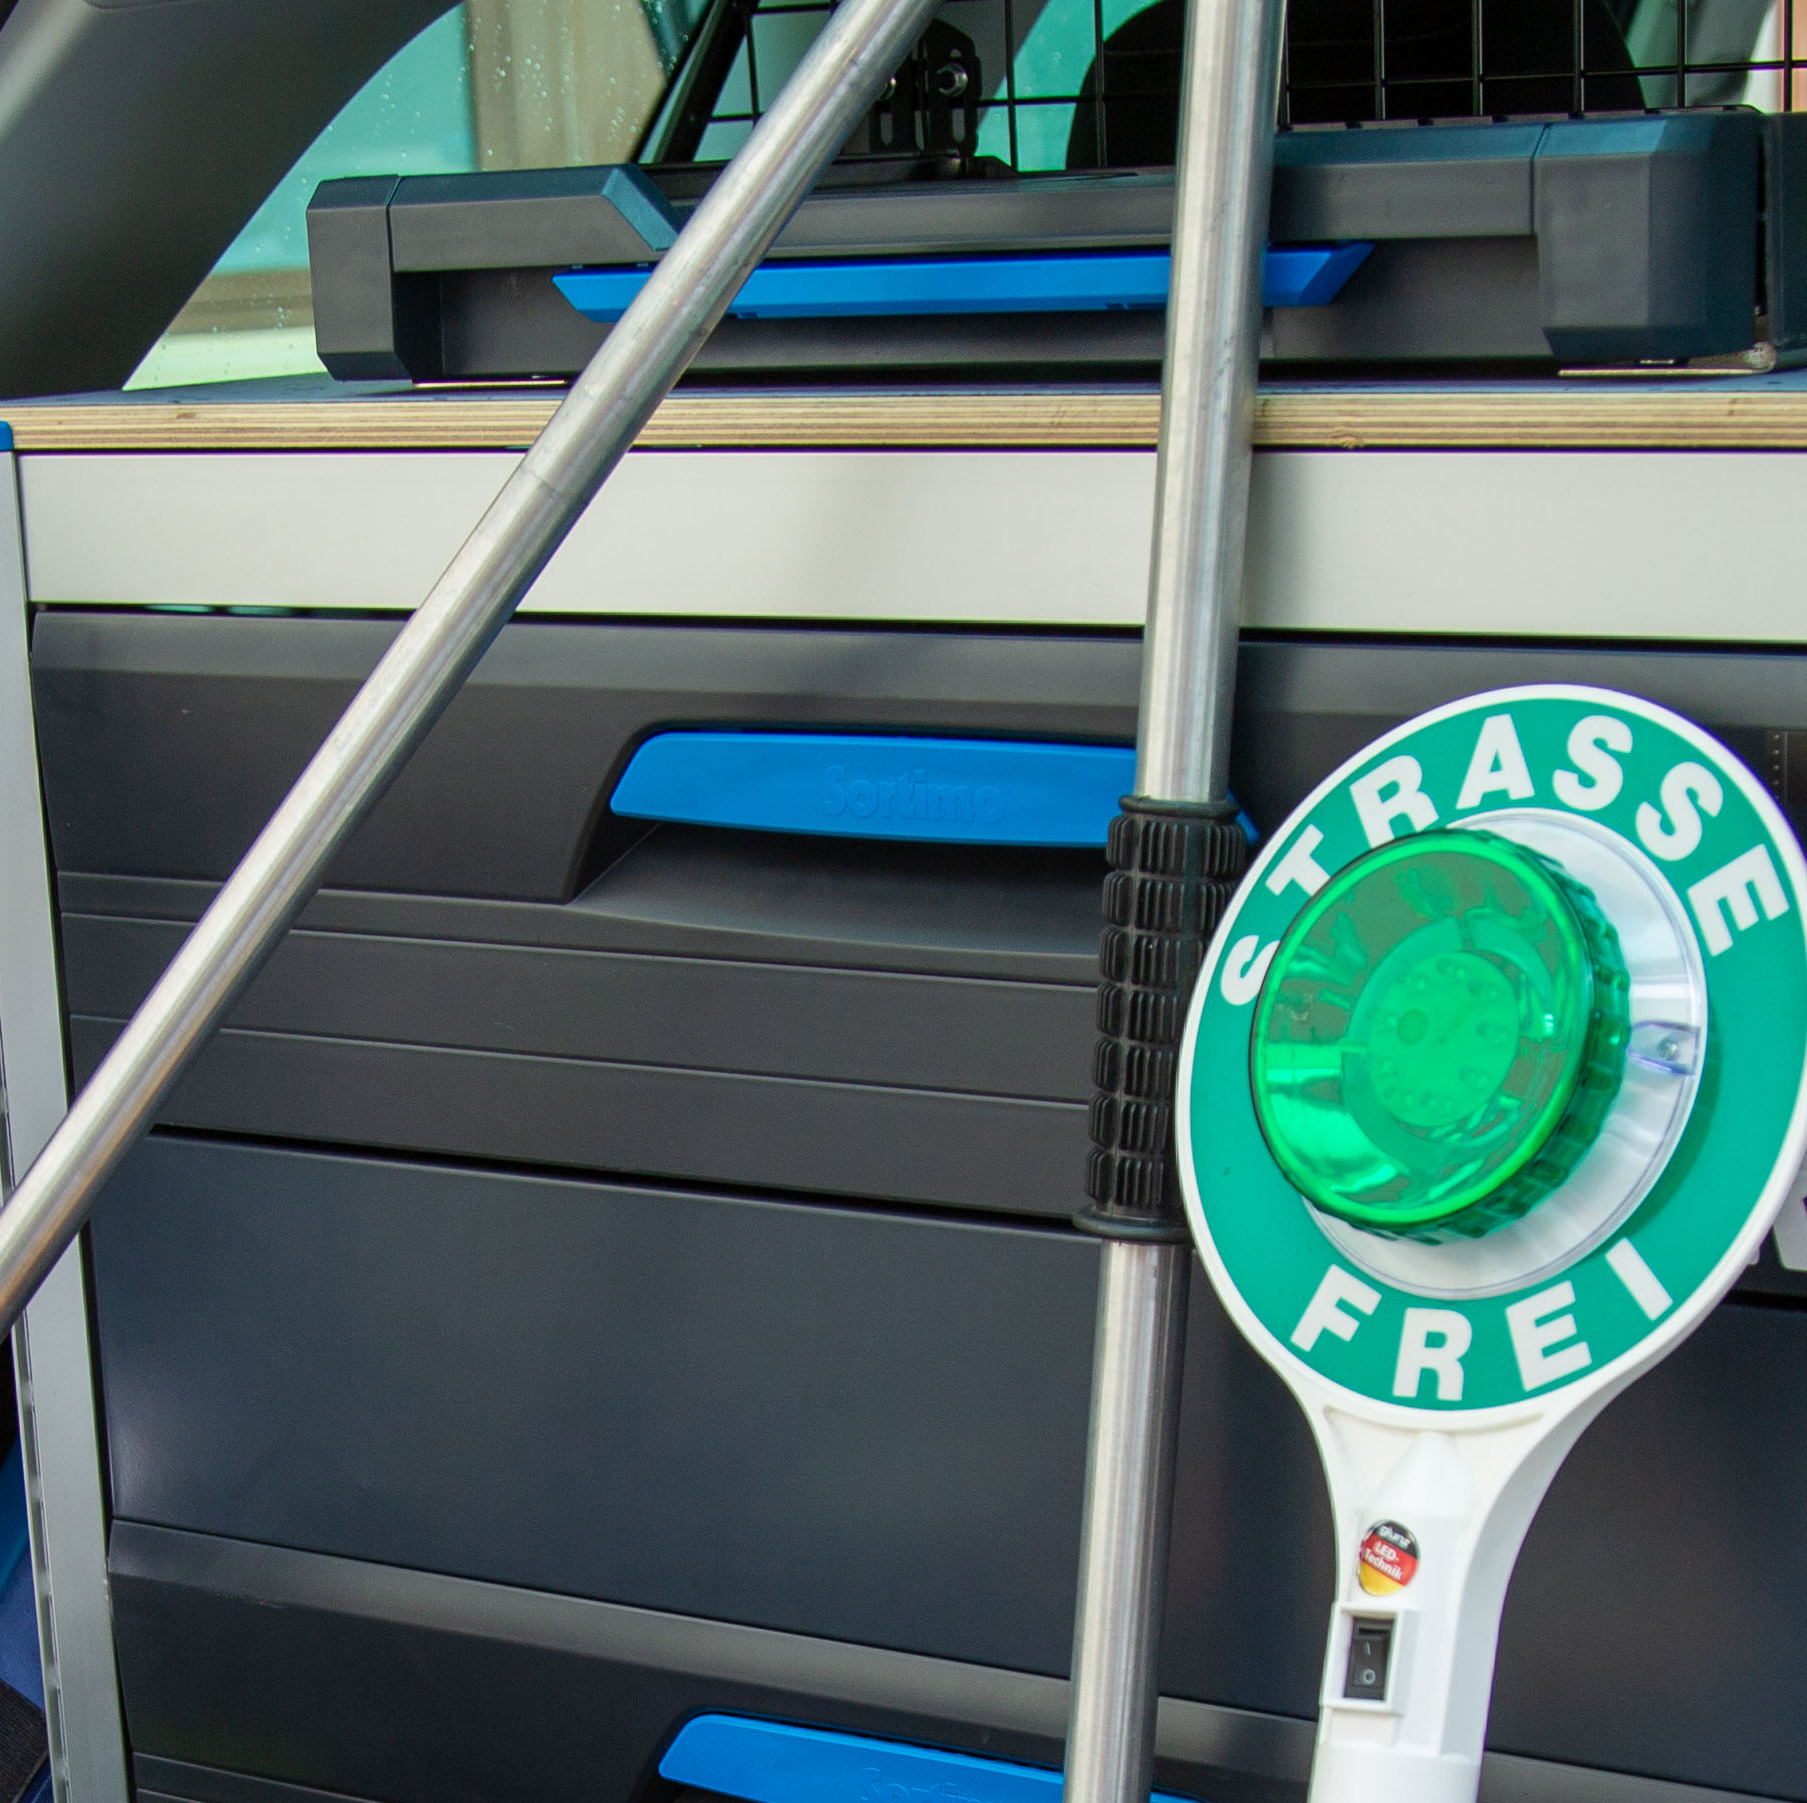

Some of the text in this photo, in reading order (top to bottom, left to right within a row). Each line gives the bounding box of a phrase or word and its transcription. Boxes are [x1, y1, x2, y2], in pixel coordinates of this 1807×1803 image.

[1221, 714, 1789, 1005] STRASSE
[1290, 1238, 1673, 1402] FREI
[1365, 1548, 1402, 1580] Technik
